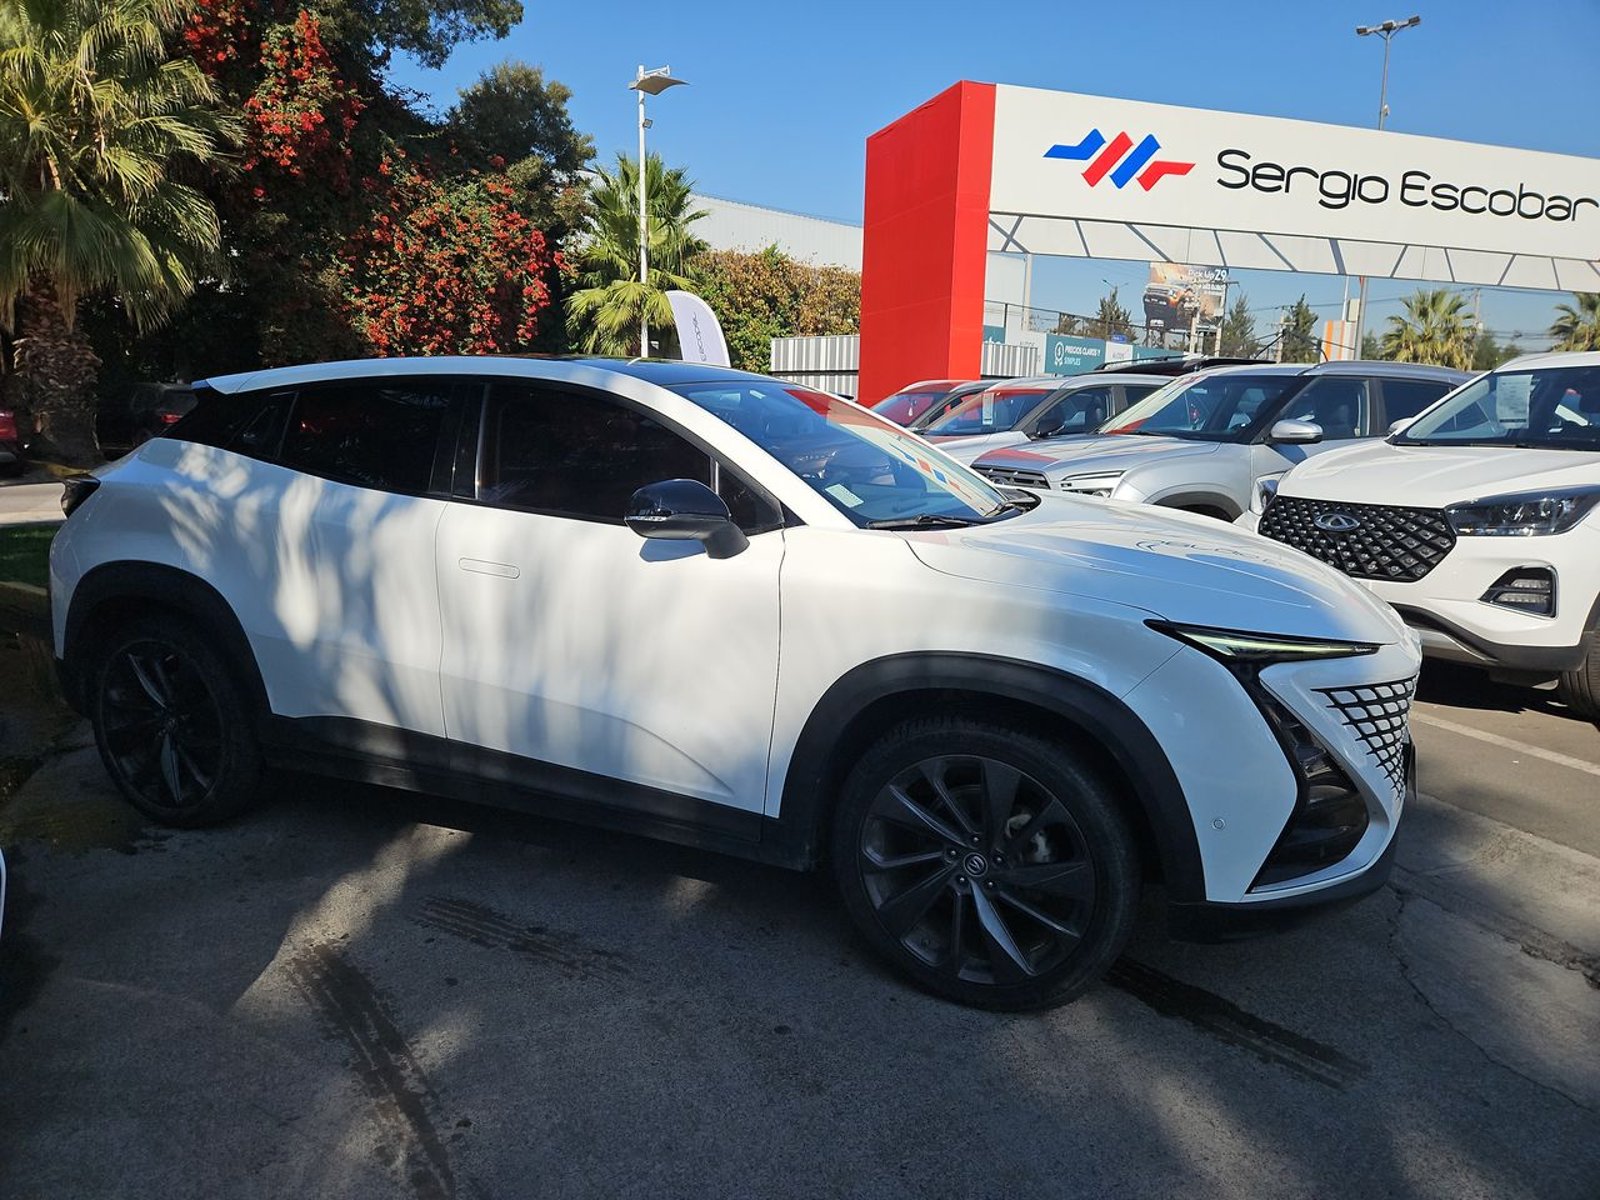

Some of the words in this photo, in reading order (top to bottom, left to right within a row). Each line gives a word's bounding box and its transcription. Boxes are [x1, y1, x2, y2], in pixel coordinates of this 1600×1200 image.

[1216, 149, 1389, 210] Sergio
[1399, 170, 1600, 222] Escobar
[1214, 269, 1227, 281] Z9
